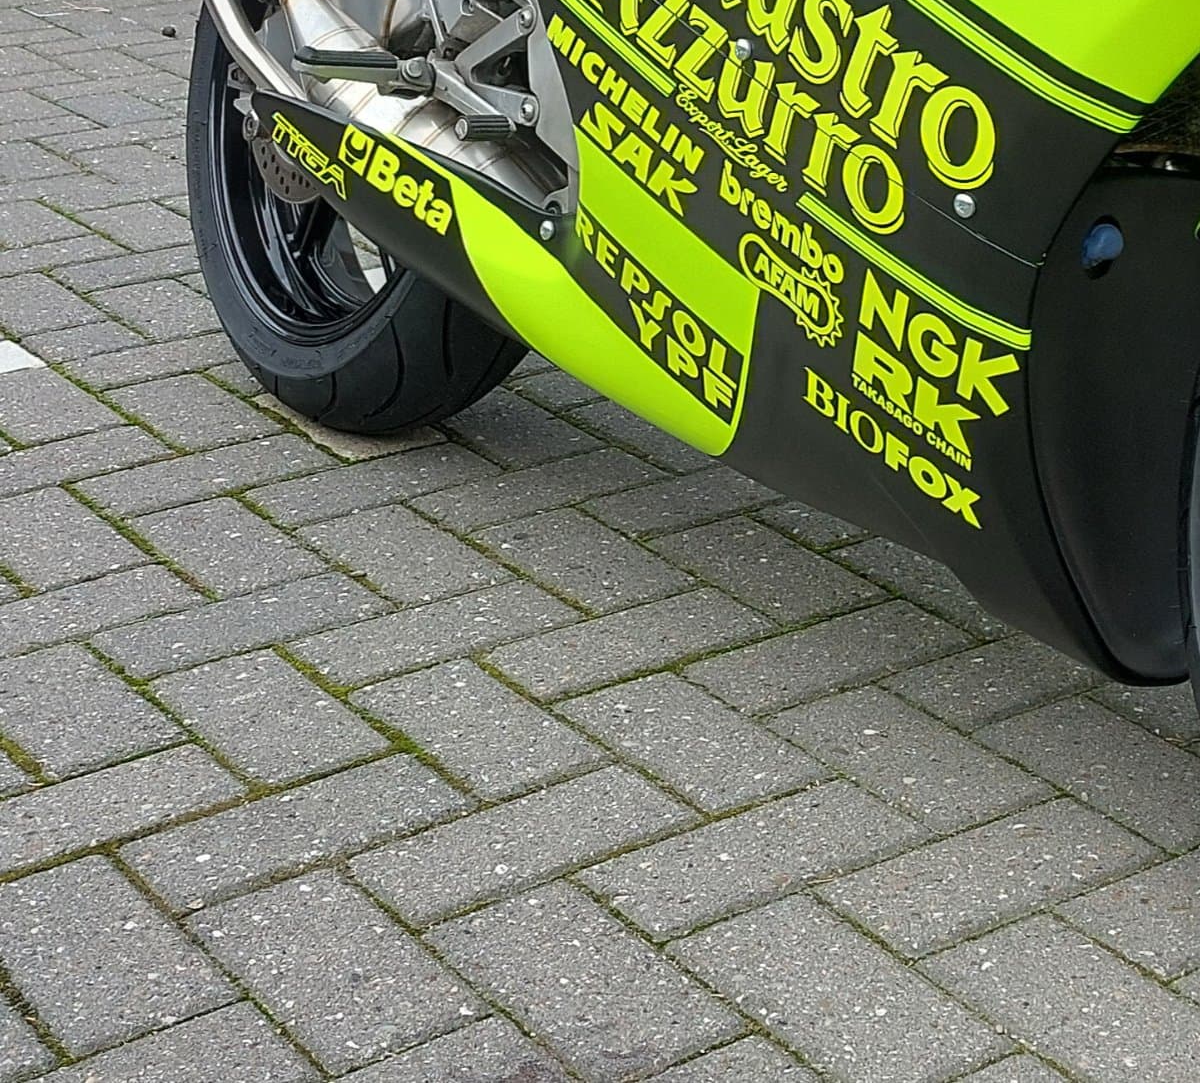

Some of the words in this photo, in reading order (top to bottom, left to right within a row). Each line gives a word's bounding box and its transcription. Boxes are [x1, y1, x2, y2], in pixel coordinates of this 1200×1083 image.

[547, 14, 705, 175] MICHELIN
[366, 145, 452, 236] Beta
[720, 159, 844, 284] brembo
[575, 211, 736, 390] REPSOL
[754, 253, 820, 321] AFAM
[861, 269, 1021, 418] NGK
[629, 299, 735, 412] YPF
[852, 329, 982, 457] RK
[851, 373, 923, 435] TAKASAGO
[926, 432, 972, 471] CHAIN
